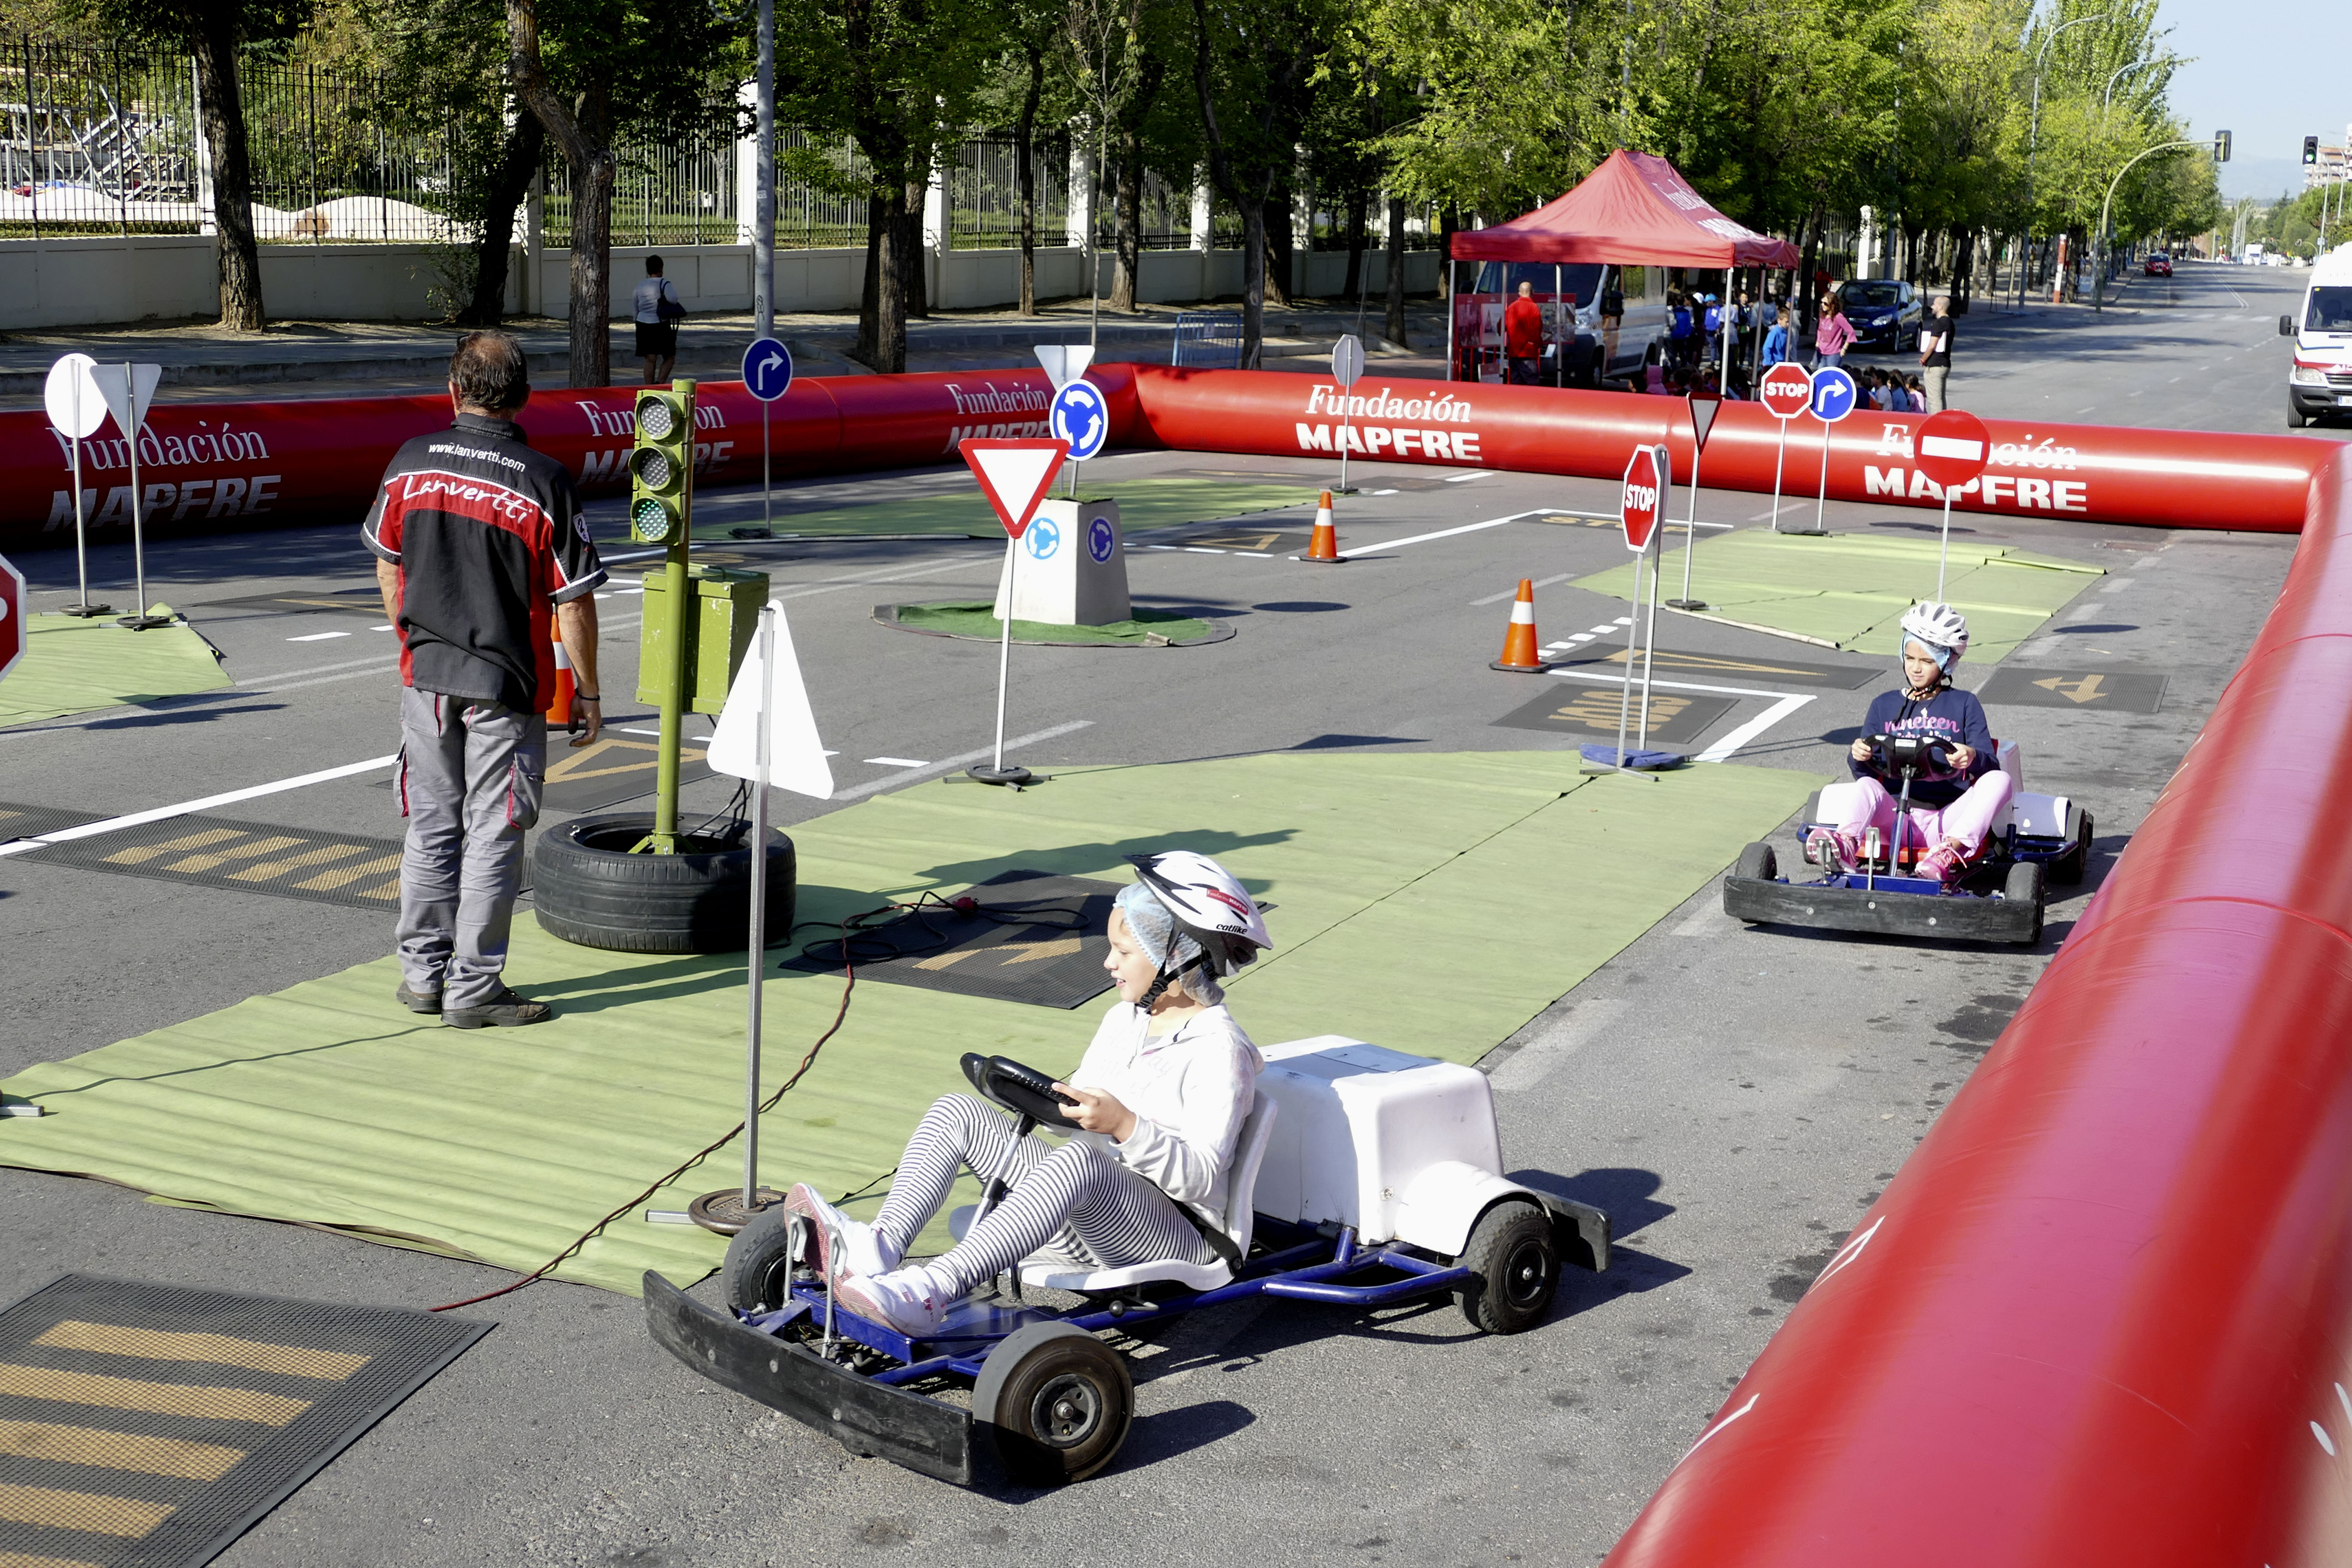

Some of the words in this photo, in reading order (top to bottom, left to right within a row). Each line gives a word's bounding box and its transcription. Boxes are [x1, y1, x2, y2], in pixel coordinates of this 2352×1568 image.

[944, 382, 1049, 414] Fundación
[1305, 384, 1471, 423] Fundación
[1766, 382, 1808, 398] STOP
[1295, 423, 1483, 461] MAPFRE
[429, 444, 526, 472] www.lanvertti.com
[43, 475, 282, 532] MAPFRE
[403, 475, 533, 524] Lanvertti
[1625, 484, 1655, 512] STOP
[1541, 516, 1696, 533] STP
[1216, 924, 1247, 934] catlike
